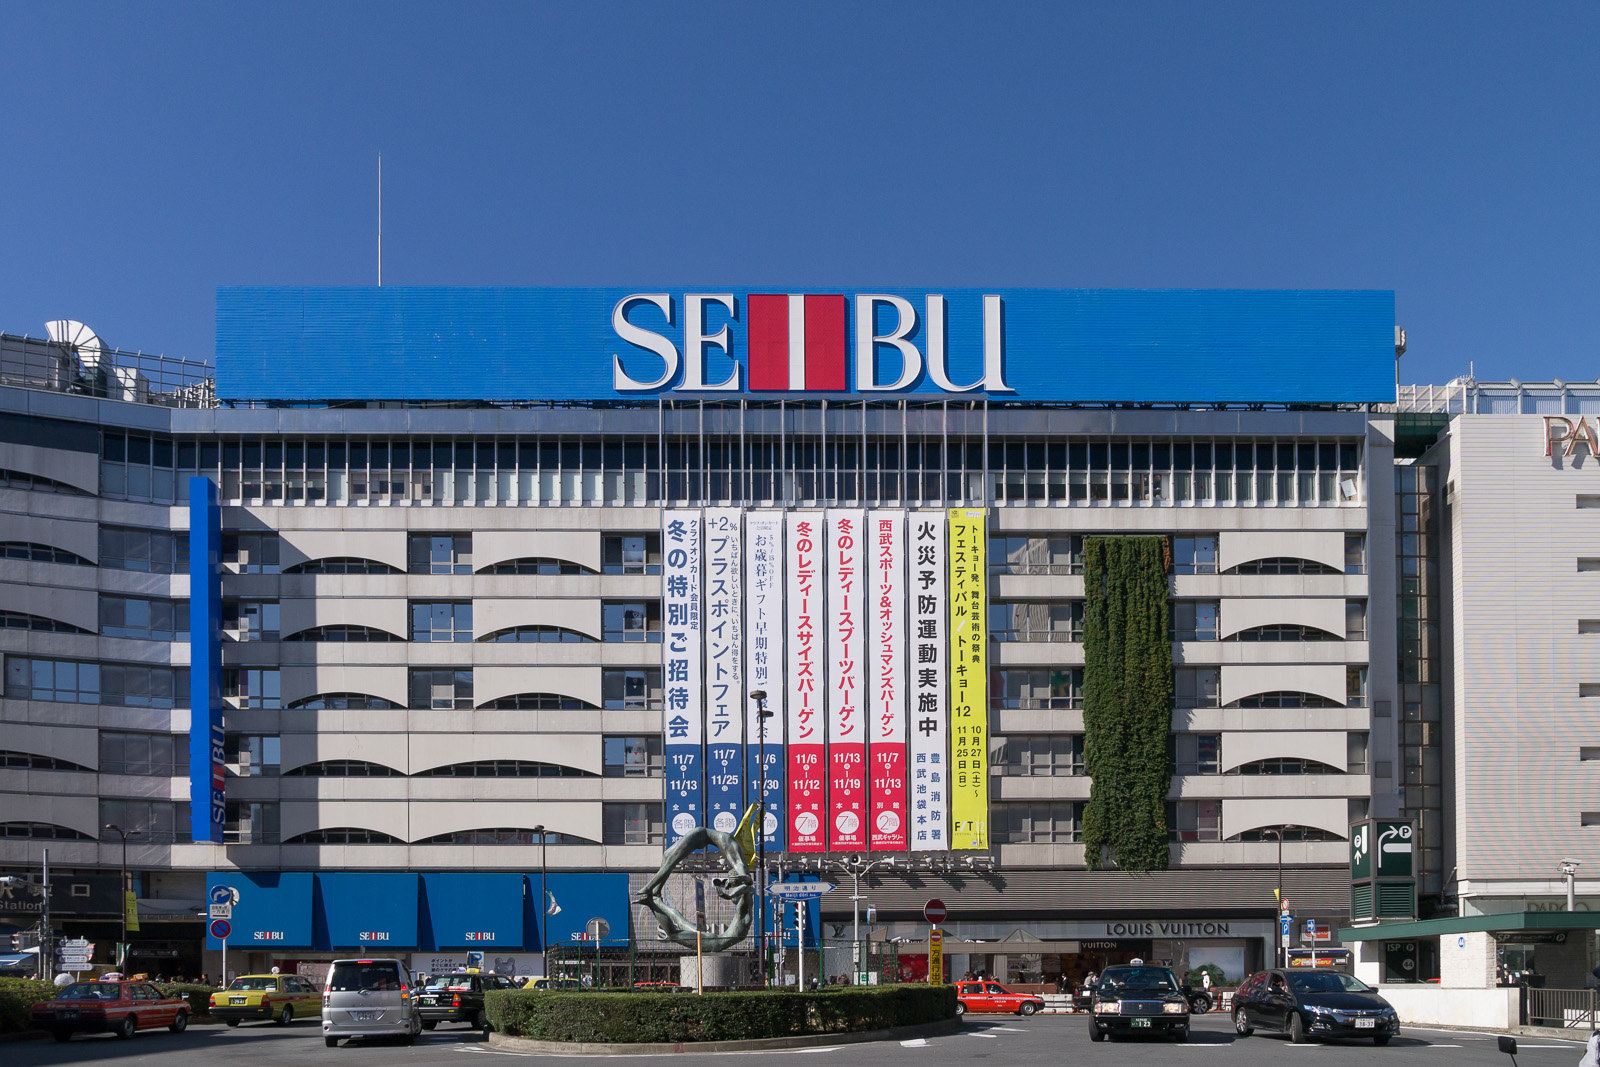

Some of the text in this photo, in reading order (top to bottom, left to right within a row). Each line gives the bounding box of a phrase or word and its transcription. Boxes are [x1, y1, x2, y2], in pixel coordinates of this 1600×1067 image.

[612, 294, 1015, 392] SEIBU
[1543, 415, 1600, 457] PA
[970, 525, 981, 663] トーキョー発、舞台芸術の祭典
[667, 520, 690, 738] 冬の特別ご招待会
[796, 522, 816, 738] 冬のレディースサイズバーゲン
[837, 519, 856, 736] 冬のレディースブーツバーゲン
[878, 519, 896, 737] 西武スポーツ&オッシュマンズバーゲン
[917, 522, 938, 737] 火災予防運動実施中
[712, 535, 731, 737] プラスポイントフェア
[673, 755, 694, 766] 11/7
[714, 750, 735, 760] 11/7
[796, 754, 817, 764] 11/6
[834, 753, 860, 763] 11/13
[877, 753, 898, 763] 11/7
[670, 780, 697, 790] 11/13
[712, 775, 738, 785] 11/25
[793, 780, 819, 790] 11/12
[834, 779, 860, 789] 11/19
[875, 778, 901, 789] 11/13
[916, 753, 928, 841] 西武池袋本店
[930, 753, 941, 840] 豊島消防署
[1106, 923, 1230, 936] LOUIS VUITTON
[254, 932, 283, 940] SEIBU
[359, 932, 389, 940] SEIBU
[465, 932, 495, 941] SEIBU
[1081, 941, 1117, 949] VUITTON
